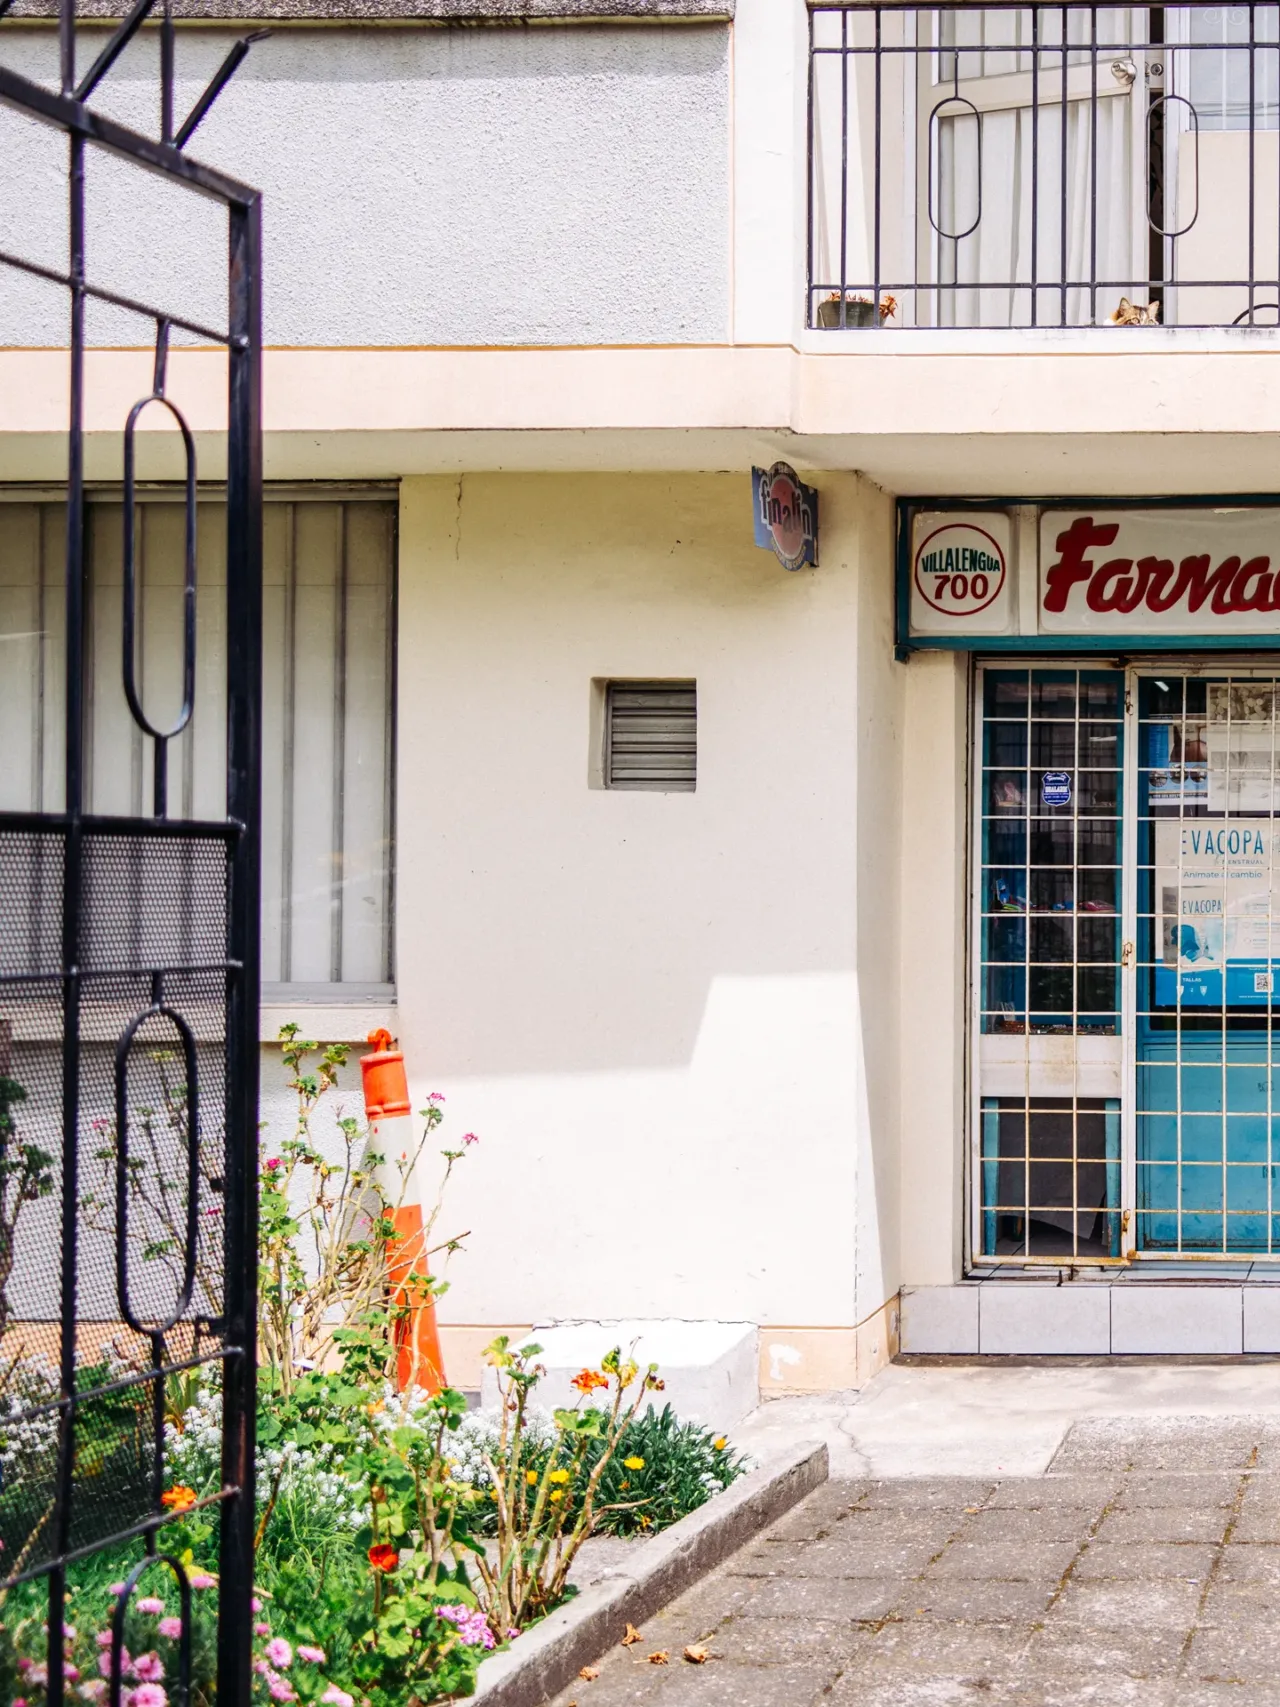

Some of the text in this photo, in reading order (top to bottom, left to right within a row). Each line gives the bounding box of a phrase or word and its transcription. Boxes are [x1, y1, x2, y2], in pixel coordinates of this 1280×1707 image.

[921, 547, 1001, 573] VILLALENGUA
[934, 573, 989, 600] 700
[1181, 829, 1264, 855] EVACOPA
[1230, 871, 1263, 879] cambio
[1182, 900, 1222, 914] EVACOPA
